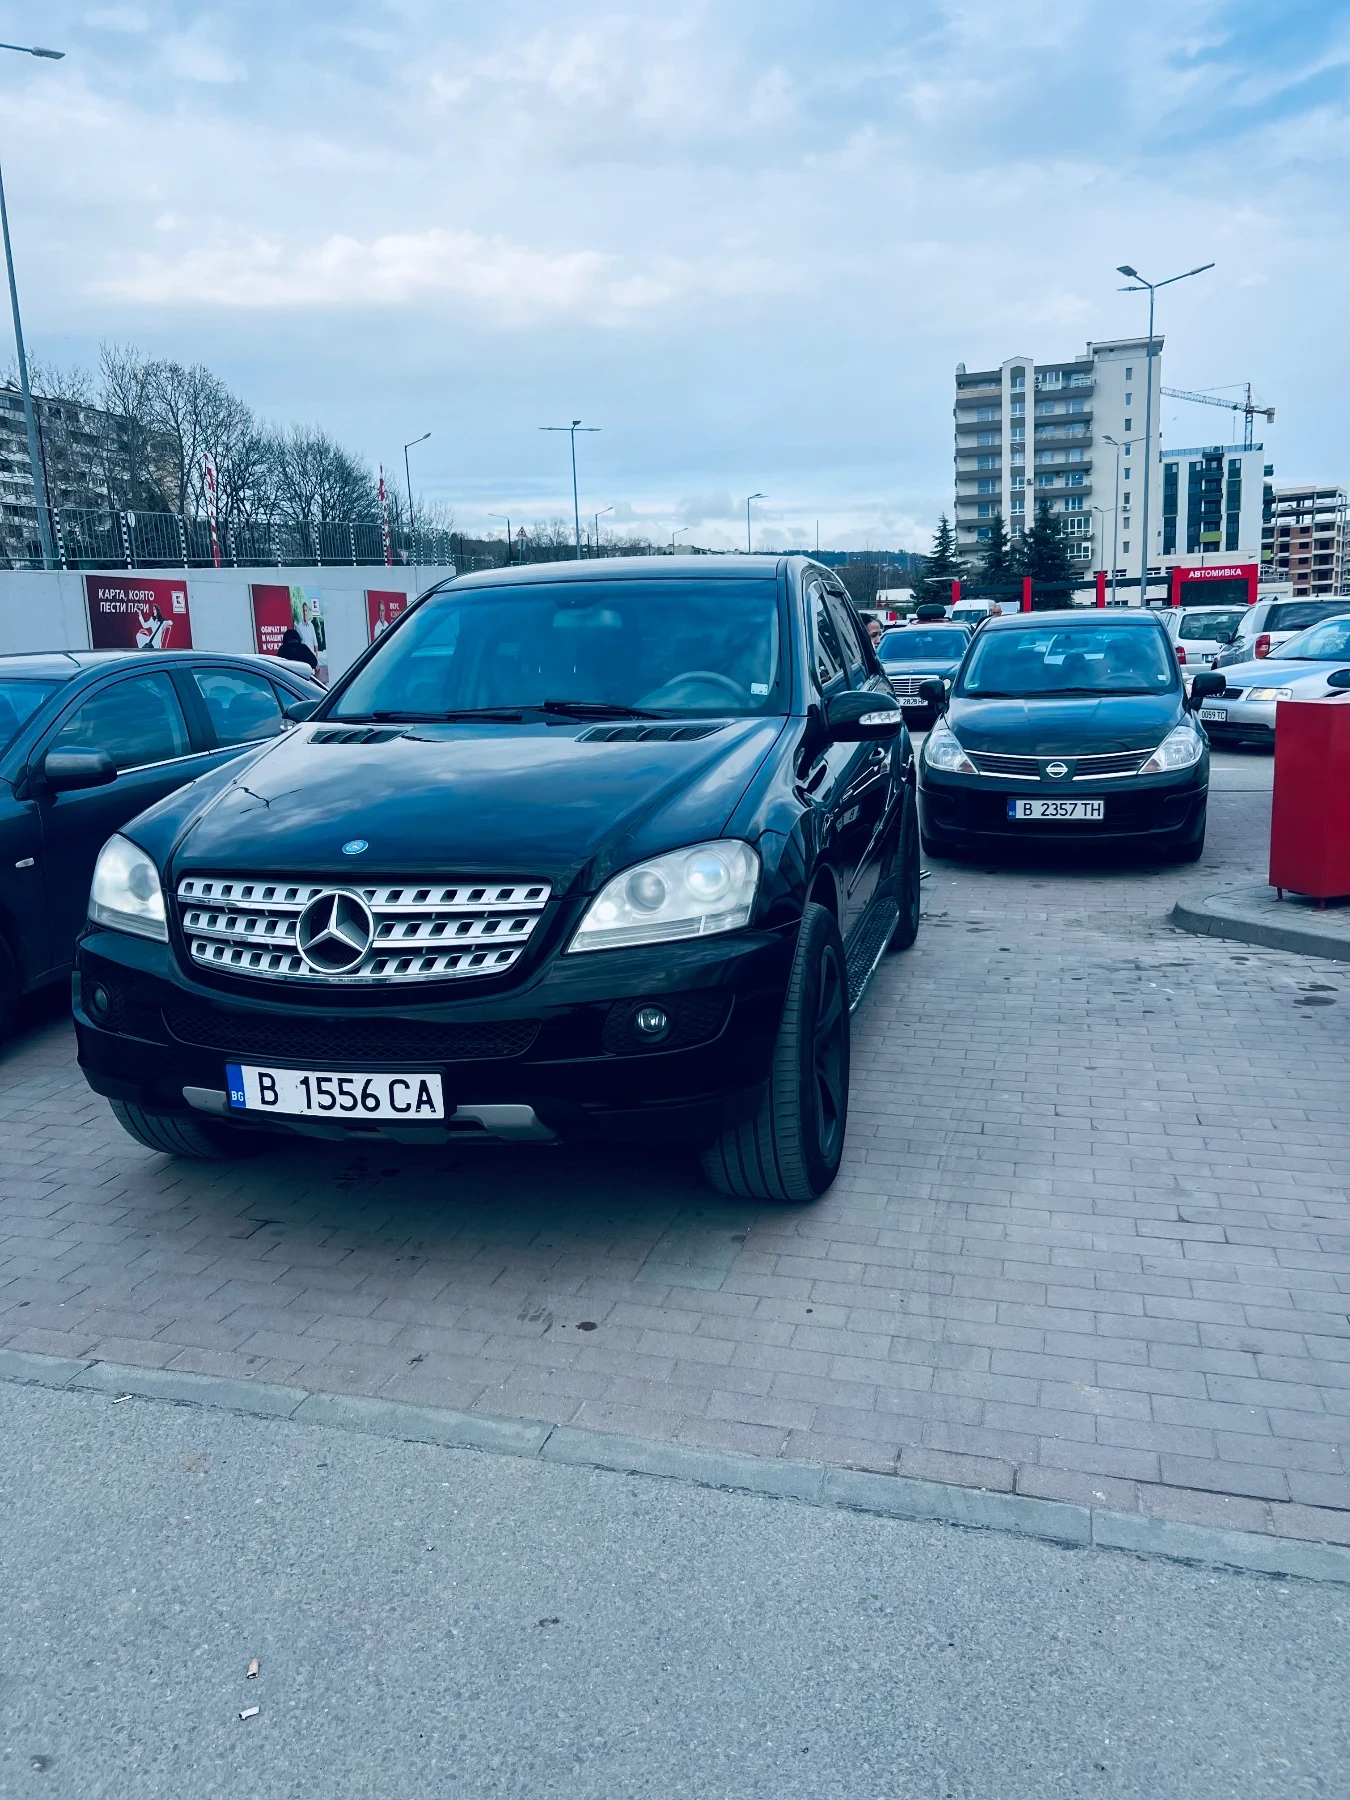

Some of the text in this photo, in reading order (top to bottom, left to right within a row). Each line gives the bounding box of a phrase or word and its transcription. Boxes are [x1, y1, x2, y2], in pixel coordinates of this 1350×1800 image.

[1188, 568, 1242, 578] АВТОМИВКА
[98, 588, 155, 601] КАРТА, КОЯТО
[100, 602, 149, 613] ПЕСТИ ПАРИ
[1201, 710, 1216, 720] 0059
[1023, 802, 1033, 817] B
[1040, 802, 1078, 817] 2357
[1081, 802, 1101, 817] TH
[231, 1071, 437, 1113] BG B 1556 CA
